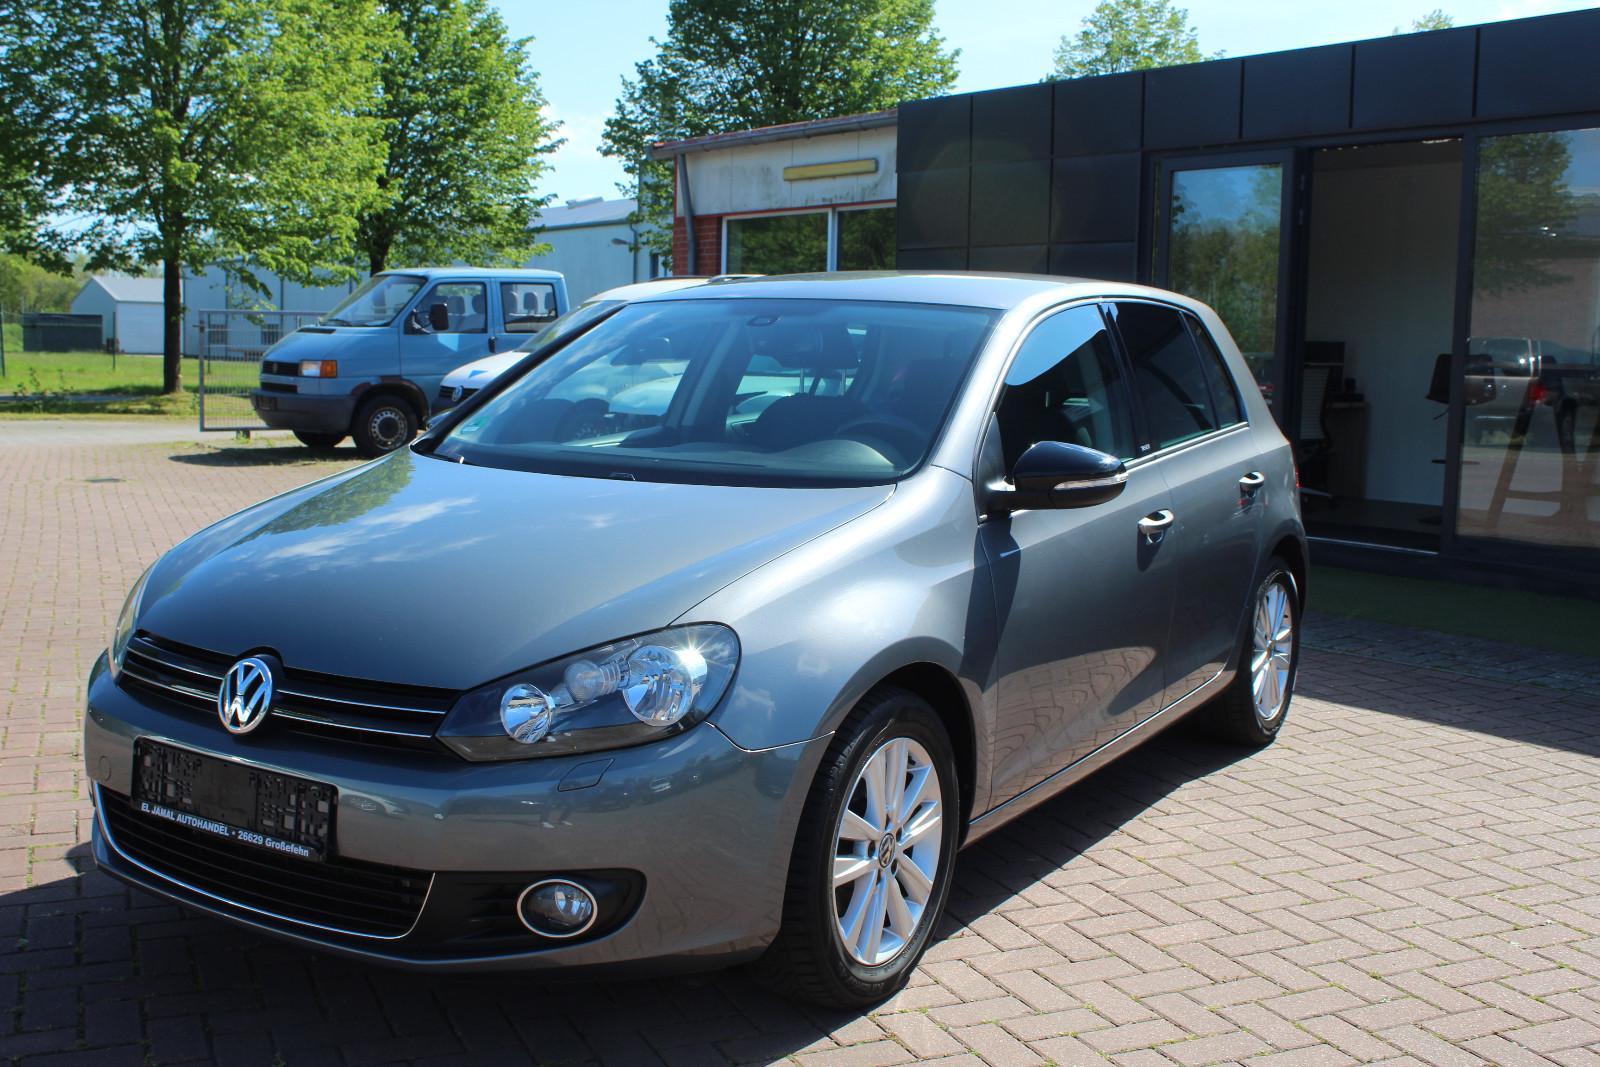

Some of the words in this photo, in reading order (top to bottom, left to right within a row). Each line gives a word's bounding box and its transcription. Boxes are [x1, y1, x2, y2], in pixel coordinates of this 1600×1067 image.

[218, 658, 272, 733] VW
[141, 802, 150, 813] EL
[151, 805, 175, 821] JAMAL
[176, 814, 230, 836] AUTOHANDEL
[238, 830, 264, 844] 26629
[265, 838, 309, 856] Großefehn
